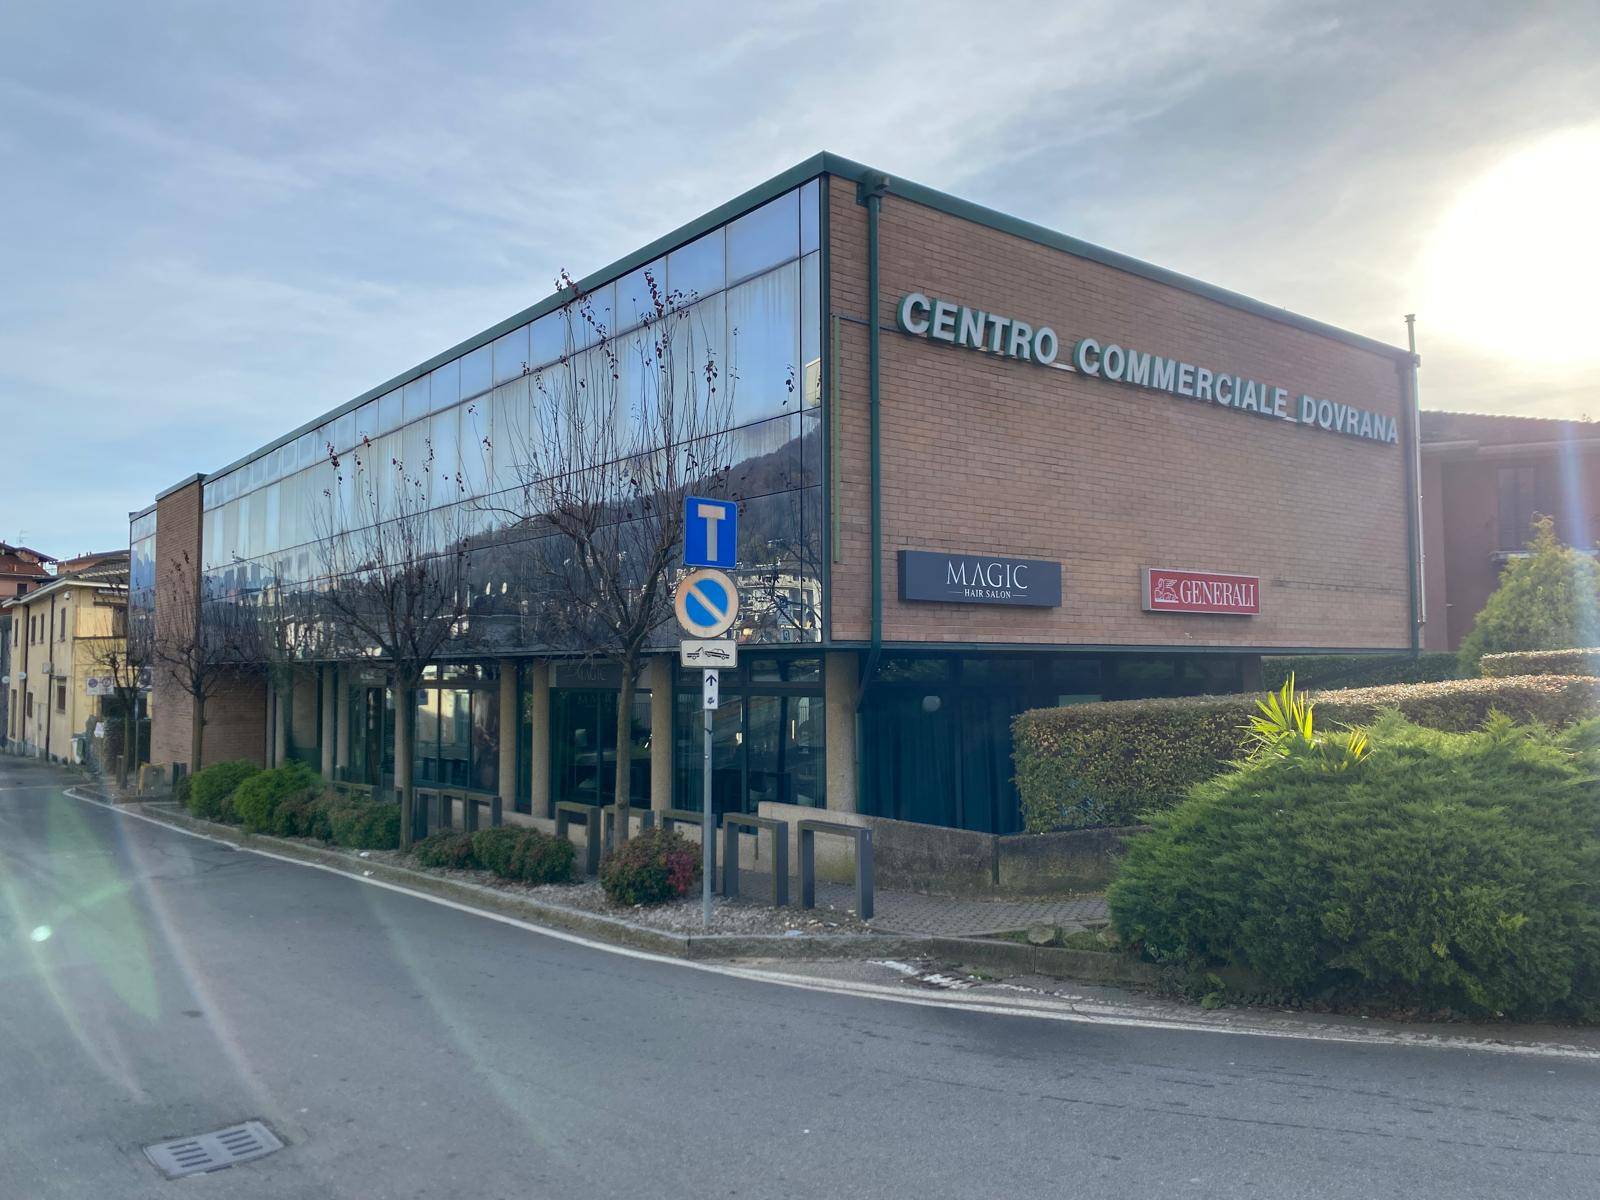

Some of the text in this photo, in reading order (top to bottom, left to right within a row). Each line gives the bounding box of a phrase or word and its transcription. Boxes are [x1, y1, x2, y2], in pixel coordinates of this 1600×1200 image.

[898, 292, 1399, 444] CENTRO COMMERCIALE DOVRANA
[946, 560, 1028, 589] MAGIC
[964, 588, 1011, 599] HAIR SALON
[1180, 580, 1256, 607] GENERALI
